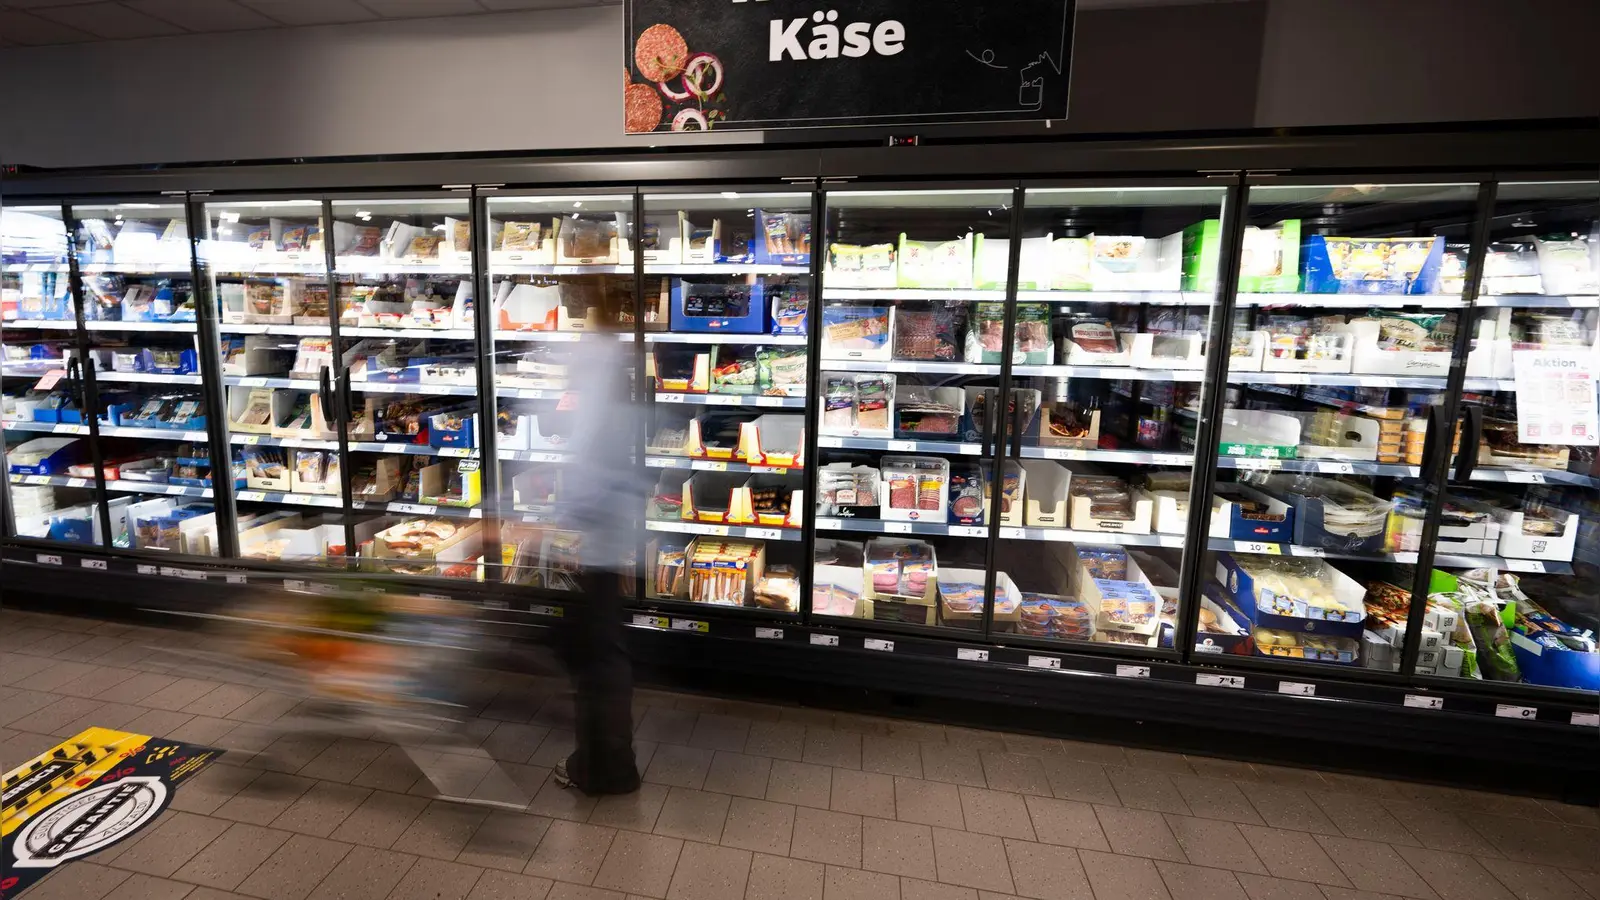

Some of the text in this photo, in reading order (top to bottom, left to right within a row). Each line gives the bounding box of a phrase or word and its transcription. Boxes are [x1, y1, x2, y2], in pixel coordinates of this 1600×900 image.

[768, 9, 906, 62] Käse
[1533, 356, 1577, 368] Aktion
[48, 784, 138, 853] GARANTIE
[102, 818, 130, 838] ALS
